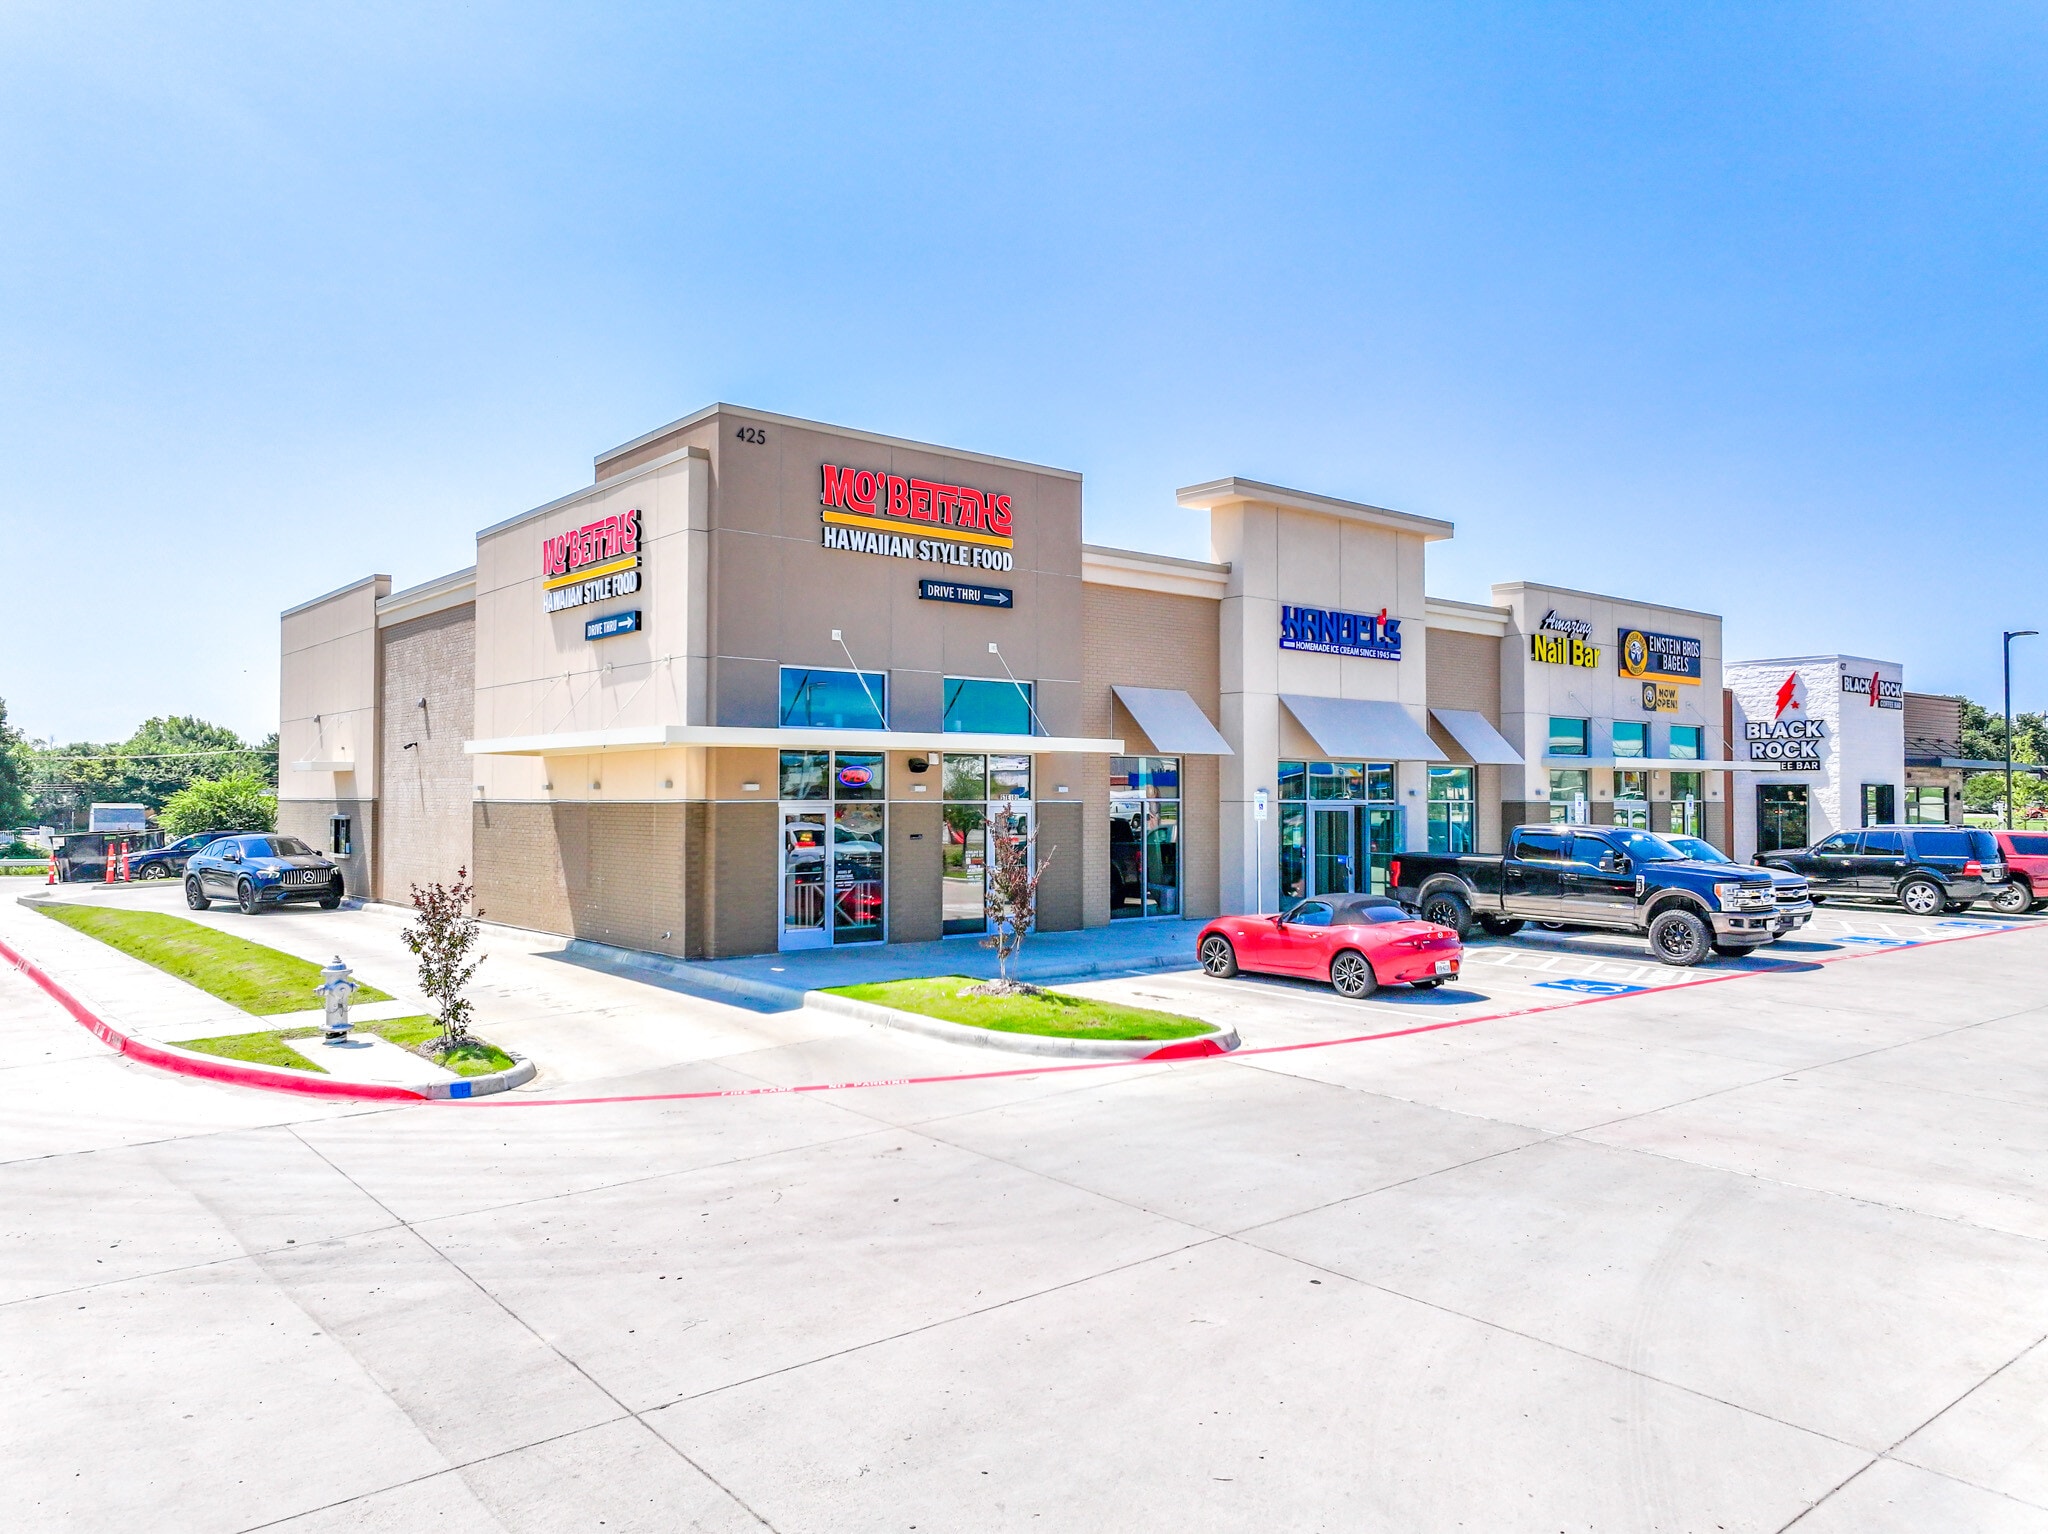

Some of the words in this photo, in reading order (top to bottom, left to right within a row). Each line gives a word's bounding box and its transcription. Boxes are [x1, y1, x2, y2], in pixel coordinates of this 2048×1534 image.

[736, 426, 766, 445] 425
[823, 526, 914, 559] HAWAIIAN
[918, 539, 969, 567] STYLE
[972, 548, 1013, 572] FOOD
[543, 584, 583, 613] HAWAIIAN
[583, 577, 612, 604] STYLE
[612, 571, 637, 597] FOOD
[927, 583, 954, 599] DRIVE
[956, 587, 981, 602] THRU
[587, 622, 603, 637] DRIVE
[603, 619, 618, 633] THRU
[1542, 609, 1593, 641] Amazing
[1295, 641, 1330, 652] HOMEMADE
[1330, 645, 1340, 654] ICE
[1340, 646, 1360, 656] CREAM
[1360, 648, 1377, 658] SINCE
[1377, 650, 1390, 659] 1945
[1534, 633, 1568, 666] Nail
[1572, 638, 1601, 668] Bar
[1649, 635, 1681, 655] EINSTEIN
[1682, 641, 1700, 658] BROS
[1662, 654, 1689, 673] BAGELS
[1658, 689, 1676, 699] NOW
[1844, 675, 1871, 695] BLACK
[1879, 681, 1903, 698] ROCK
[1657, 699, 1678, 709] OPEN!
[1745, 720, 1825, 740] BLACK
[1750, 740, 1820, 760] ROCK
[1796, 761, 1818, 770] BAR
